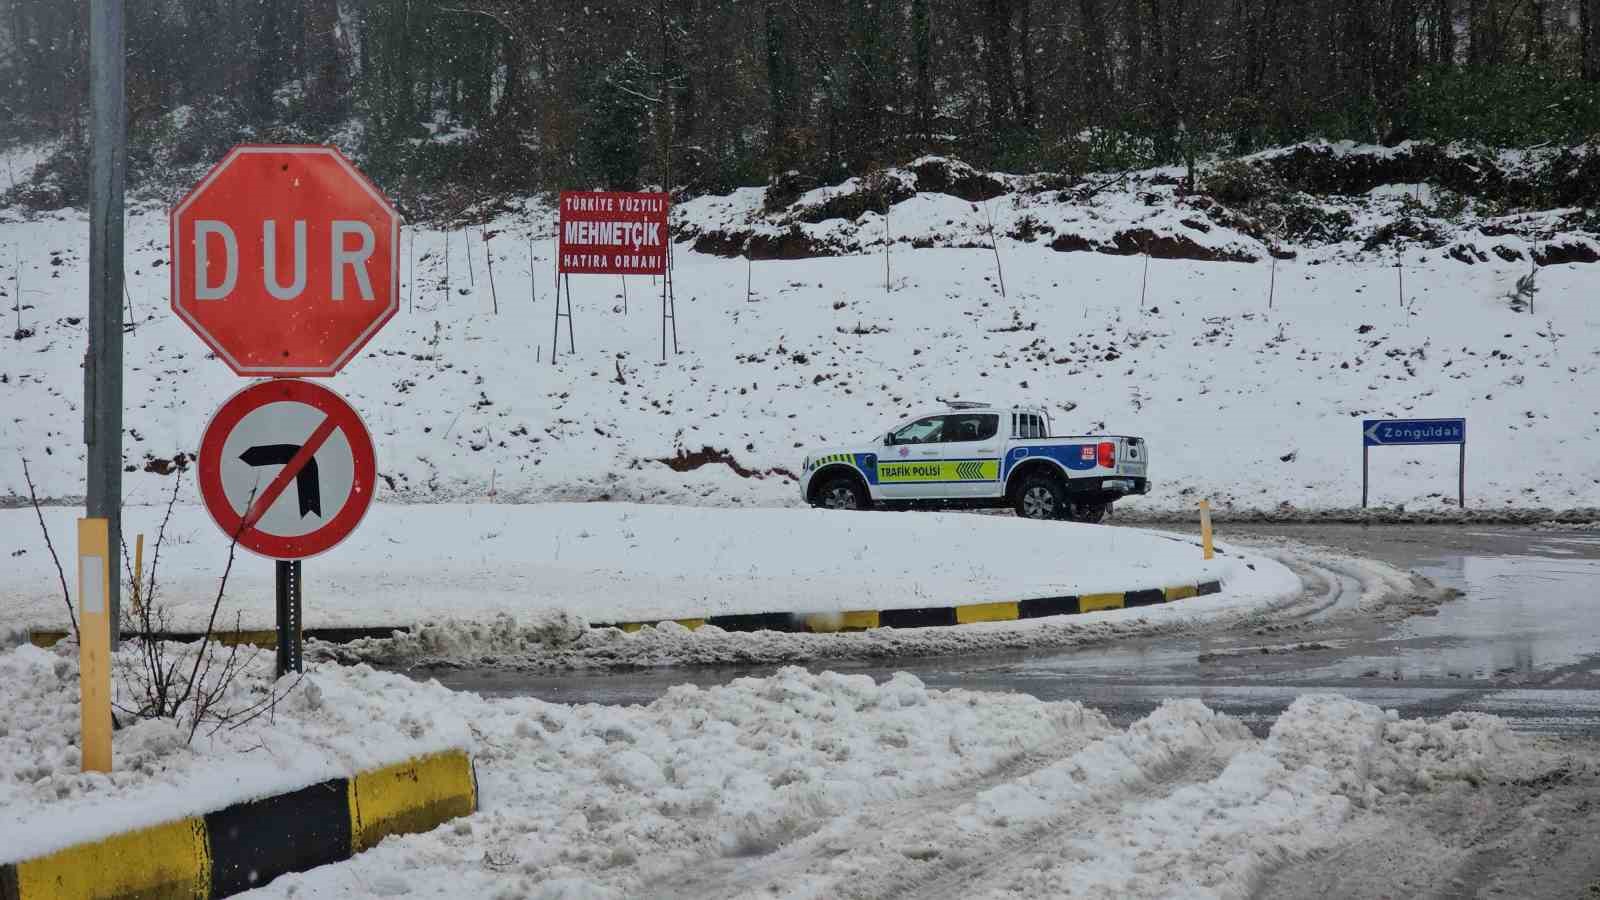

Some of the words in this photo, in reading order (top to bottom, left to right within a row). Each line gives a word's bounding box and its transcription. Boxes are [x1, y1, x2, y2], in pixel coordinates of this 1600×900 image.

[566, 195, 613, 211] TÜRKİYE
[619, 196, 663, 212] YÜZYILI
[565, 216, 660, 251] MEHMETÇİK
[195, 219, 376, 301] DUR
[564, 254, 608, 268] HATIRA
[615, 254, 661, 269] ORMANI
[1384, 426, 1460, 440] Zonguldak
[881, 464, 911, 477] TRAFİK
